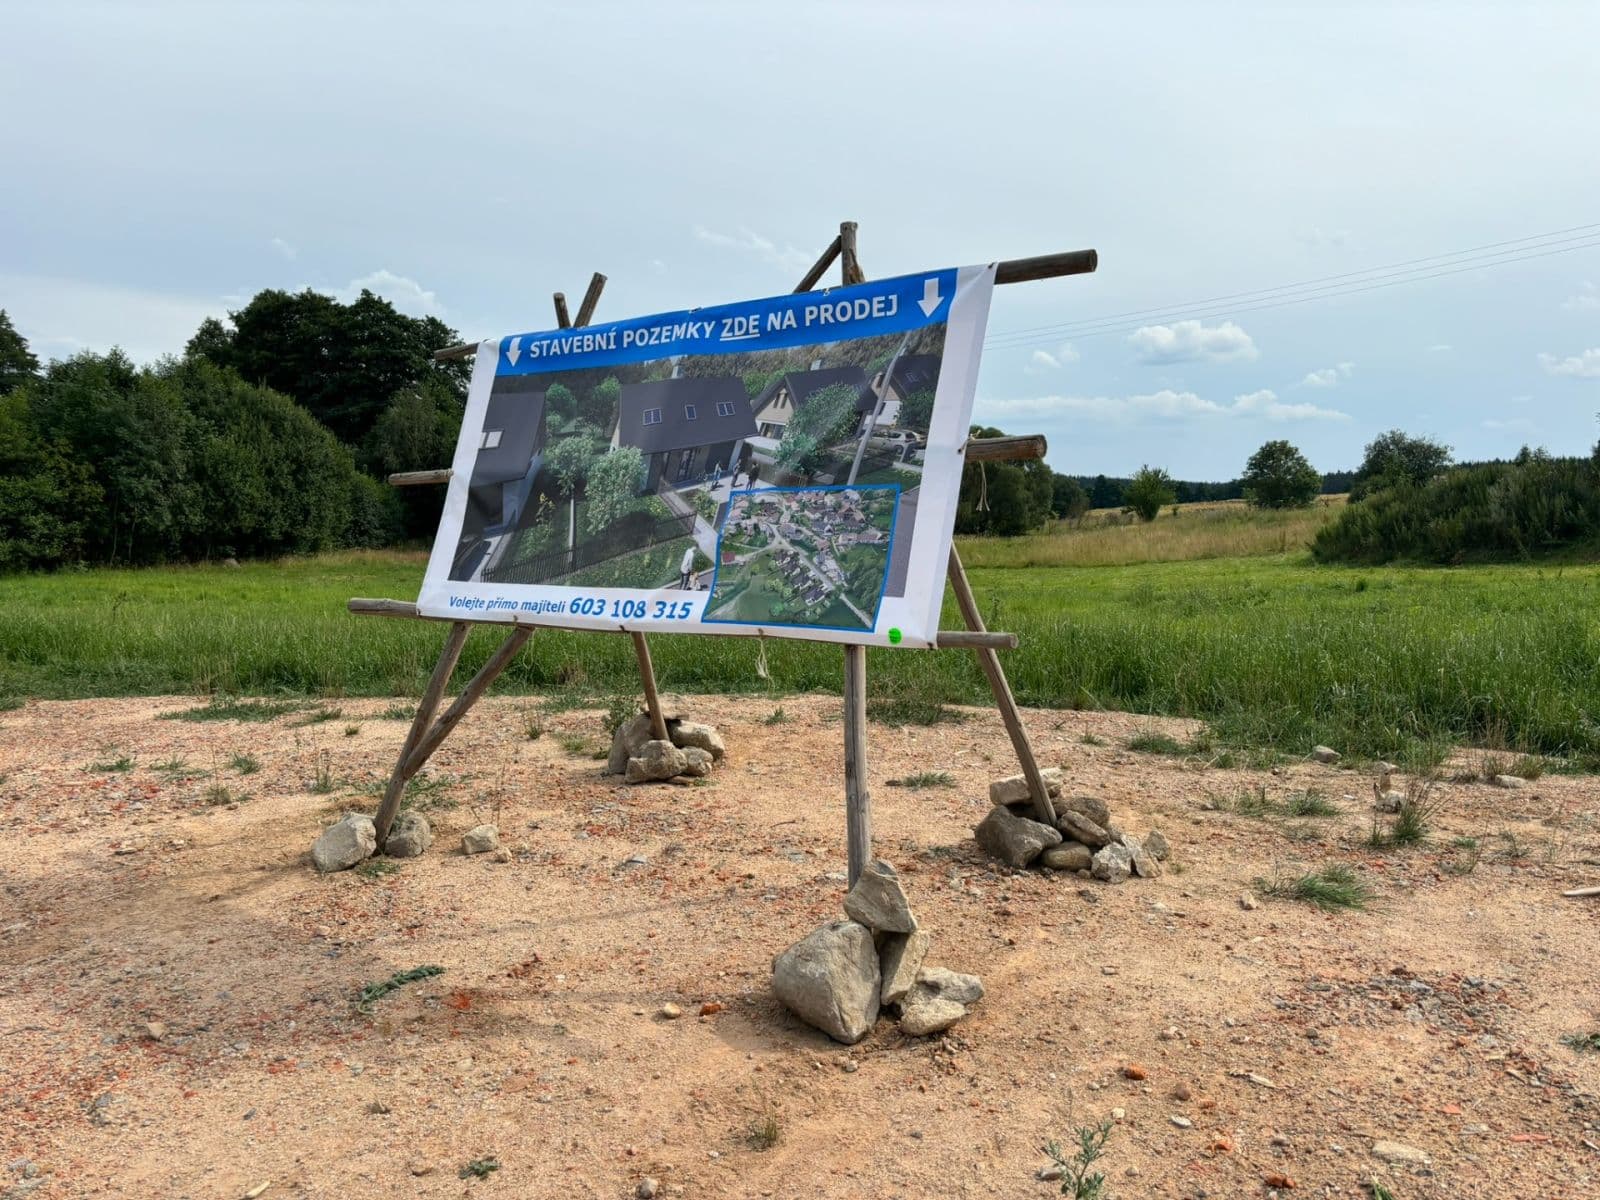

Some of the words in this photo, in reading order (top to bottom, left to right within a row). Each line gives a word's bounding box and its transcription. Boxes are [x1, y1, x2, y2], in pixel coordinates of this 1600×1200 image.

[529, 327, 617, 359] STAVEBNÍ
[622, 322, 715, 348] POZEMKY
[719, 315, 761, 341] ZDE
[766, 311, 796, 331] NA
[804, 294, 899, 326] PRODEJ
[449, 596, 485, 609] Volejte
[486, 597, 519, 612] přímo
[520, 599, 566, 614] majiteli
[569, 597, 606, 616] 603
[611, 600, 647, 618] 108
[653, 600, 694, 620] 315
